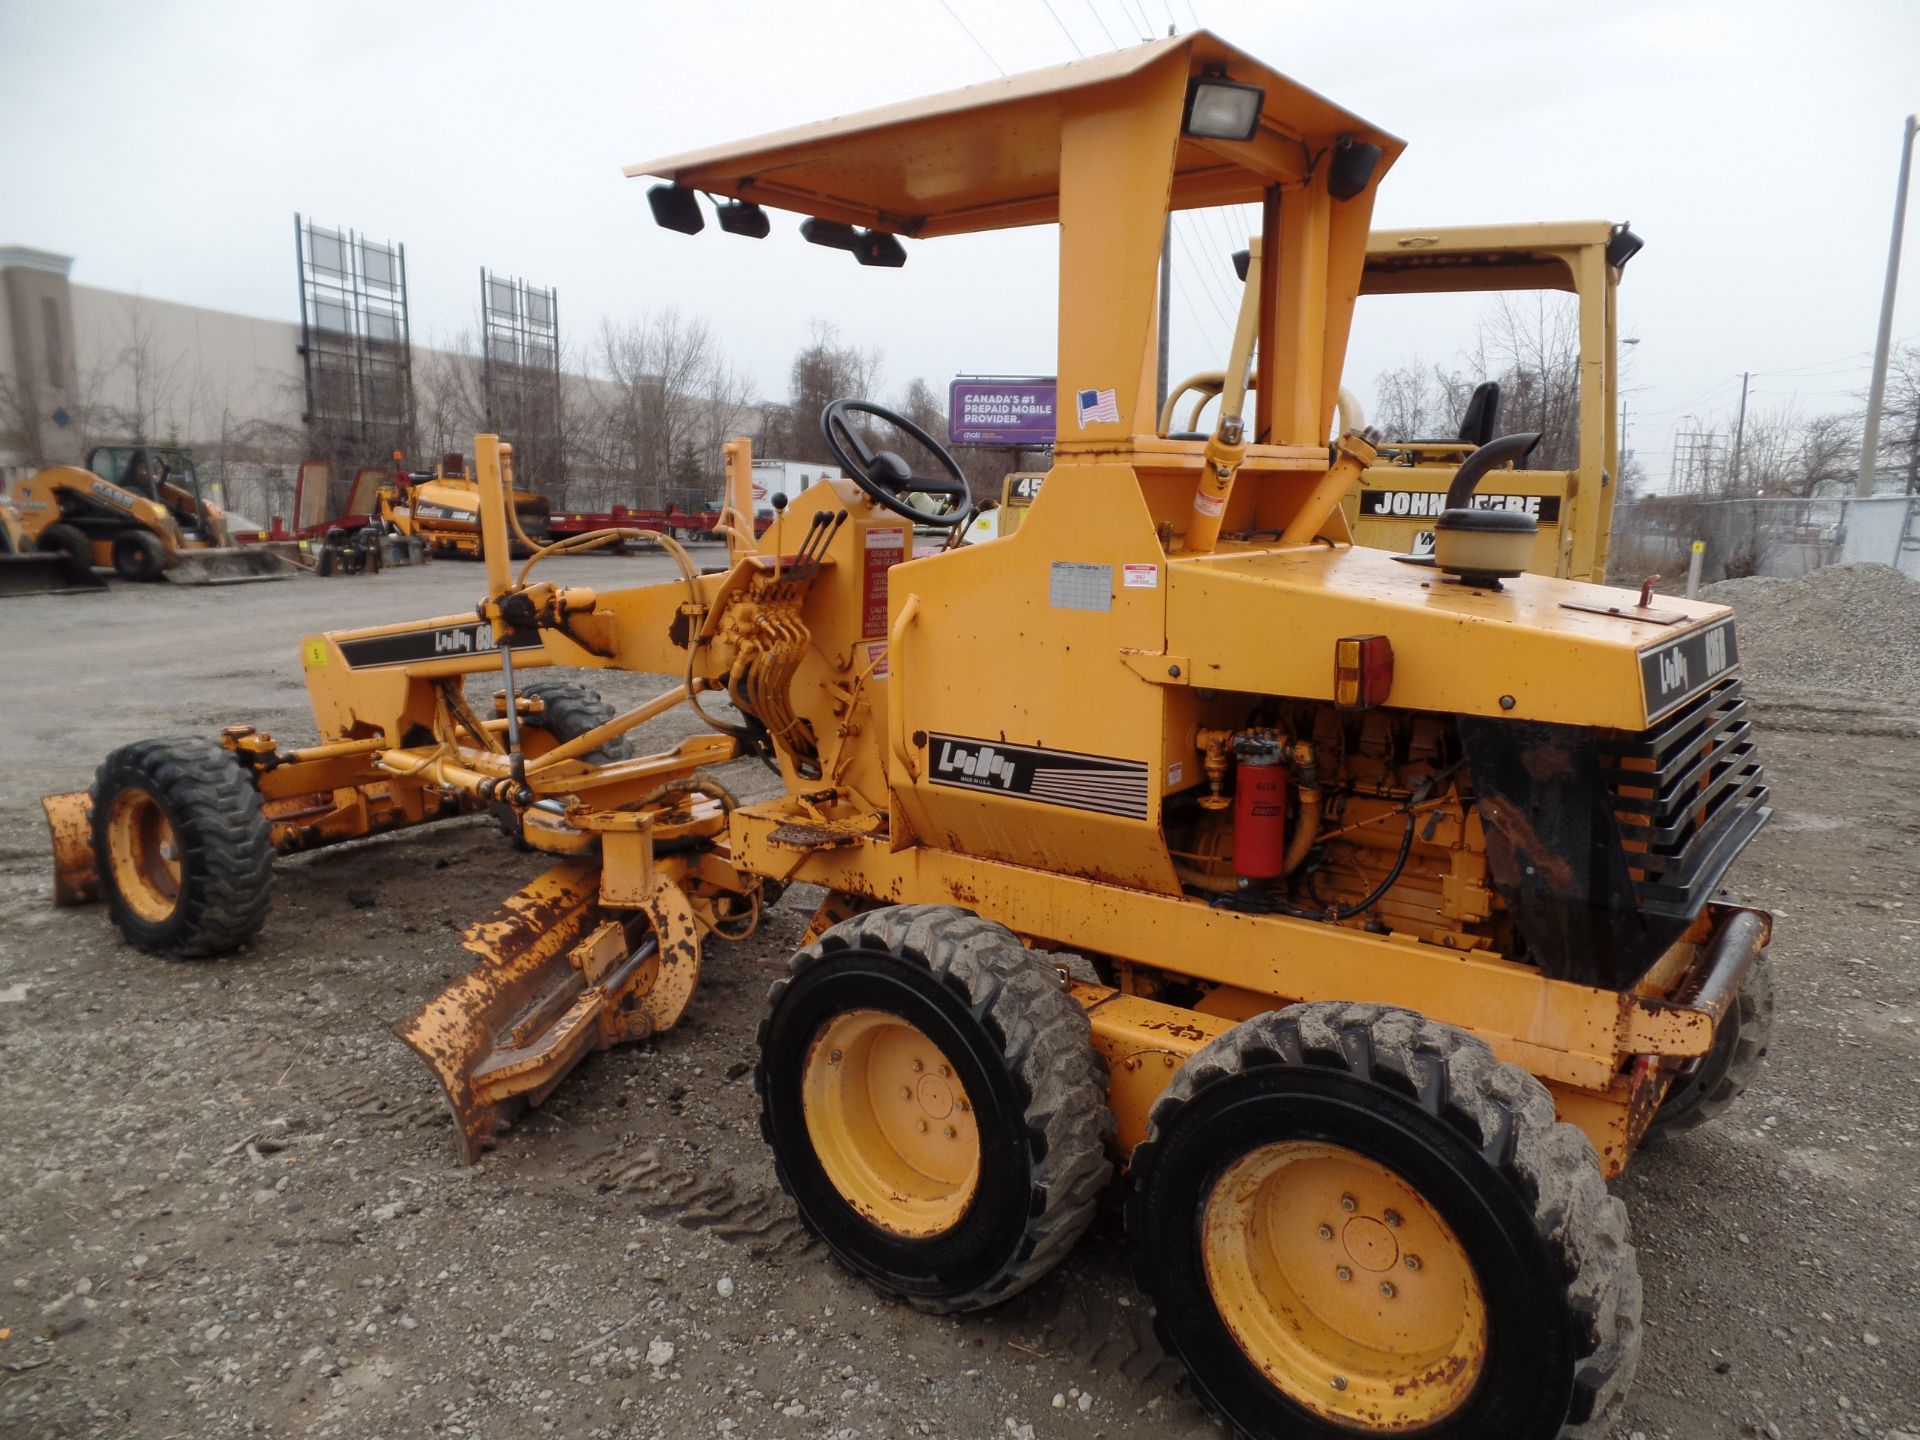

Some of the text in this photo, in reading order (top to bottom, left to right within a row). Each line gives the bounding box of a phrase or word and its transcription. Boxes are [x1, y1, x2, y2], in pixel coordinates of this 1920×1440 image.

[964, 394, 1035, 404] CANADA'S #1
[964, 404, 1052, 414] PREPAID MOBILE
[964, 414, 1021, 423] PROVIDER.
[92, 481, 135, 509] CASE
[1374, 491, 1448, 516] JOHN
[313, 648, 320, 660] 5
